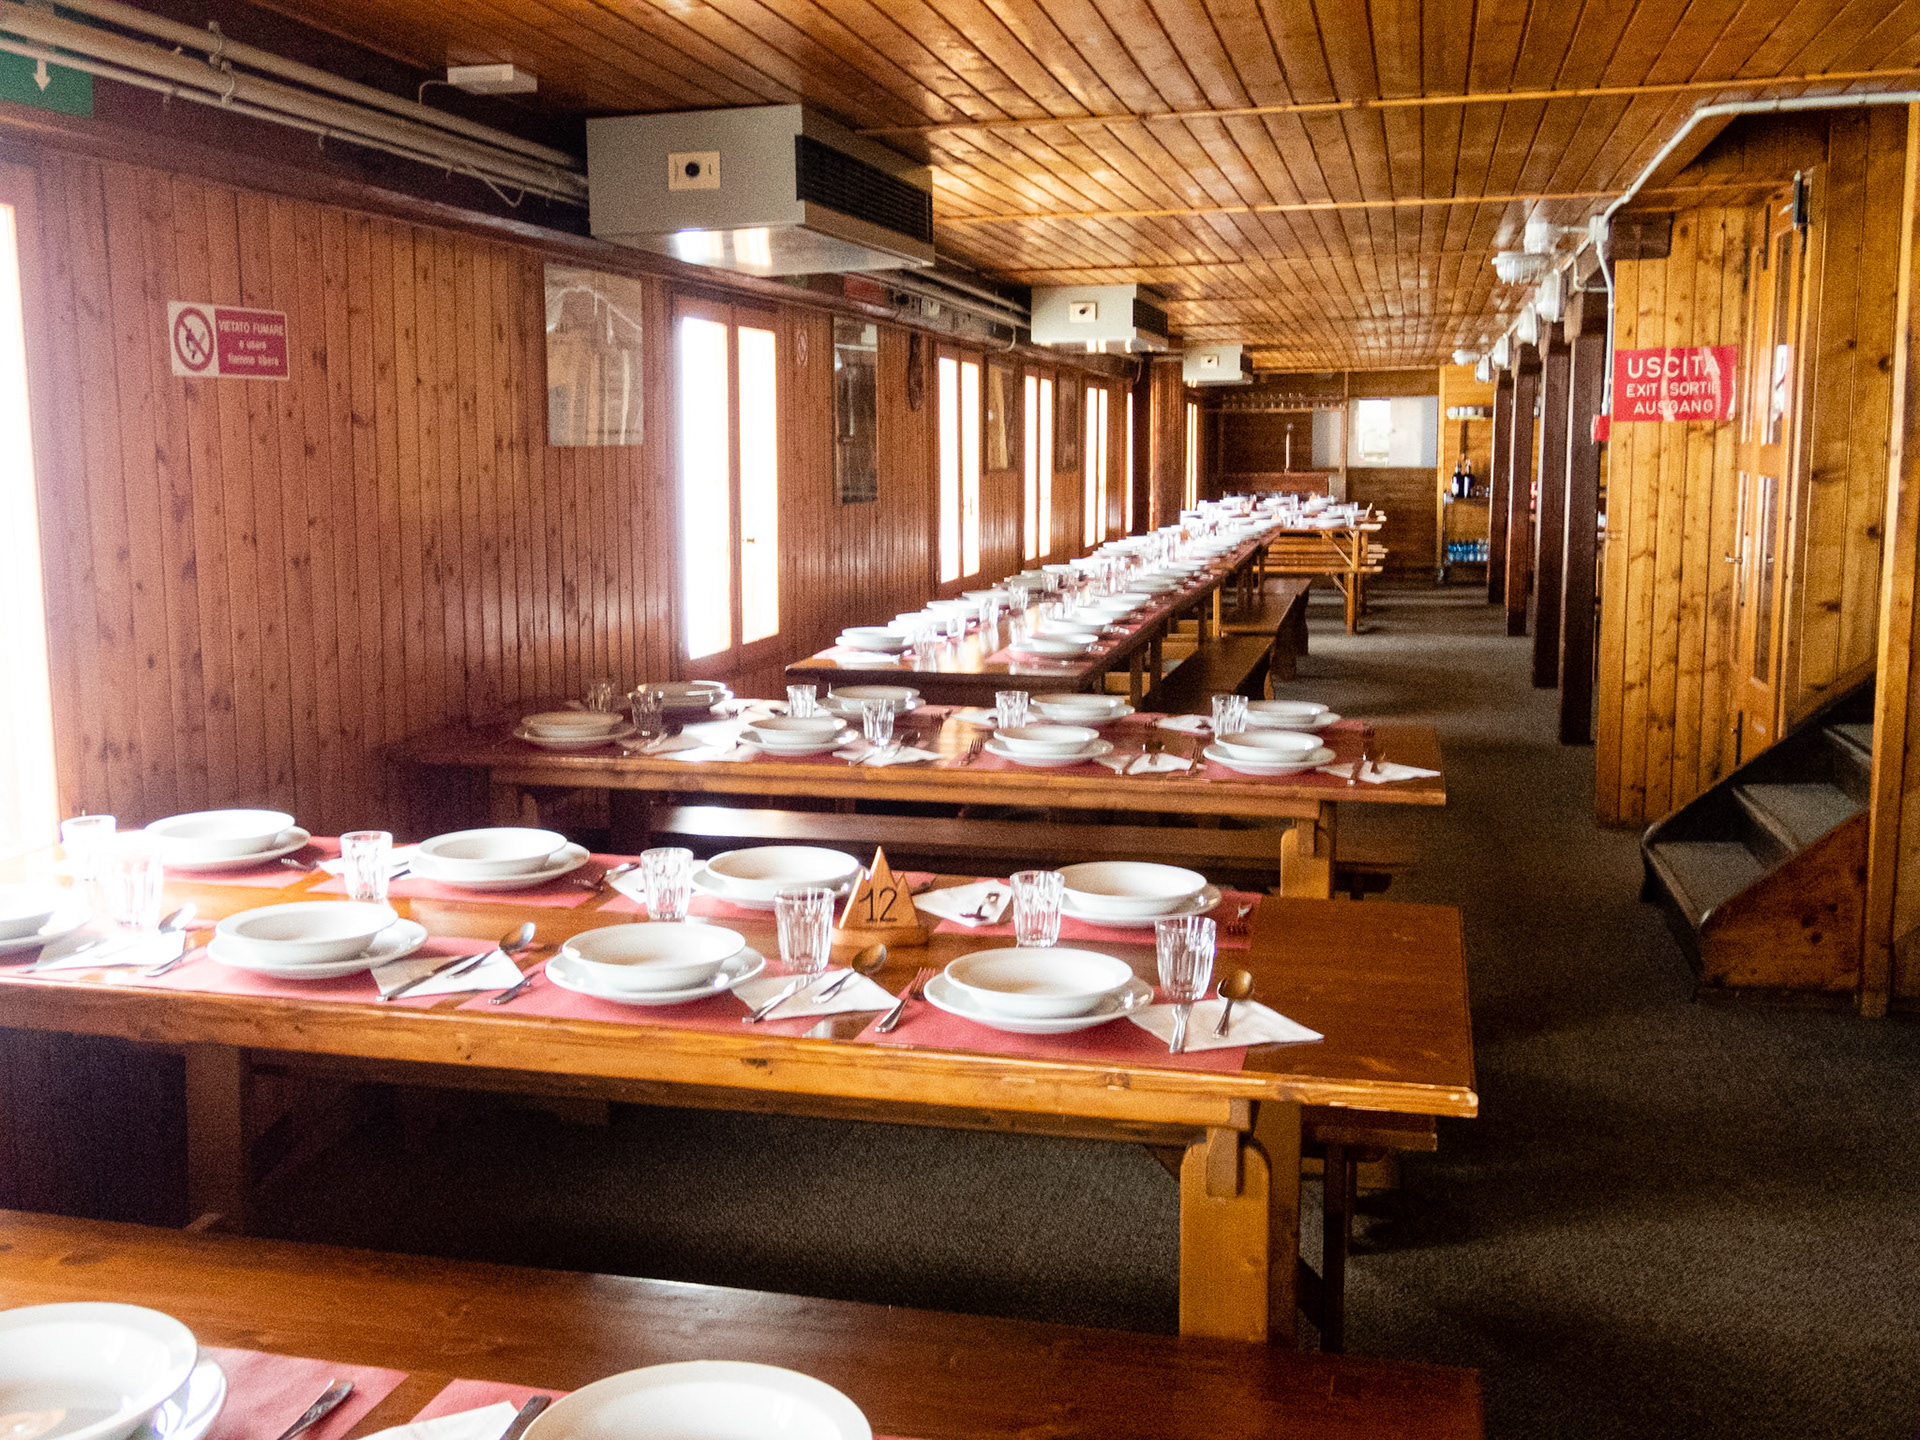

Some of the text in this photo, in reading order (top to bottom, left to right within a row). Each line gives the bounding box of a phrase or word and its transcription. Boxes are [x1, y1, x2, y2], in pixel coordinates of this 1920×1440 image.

[219, 319, 284, 337] VIETATO FUMARE
[1627, 356, 1721, 379] USCITA
[1626, 381, 1718, 398] EXIT SORTIE
[1633, 399, 1714, 415] AUSGANG
[859, 886, 898, 922] 12
